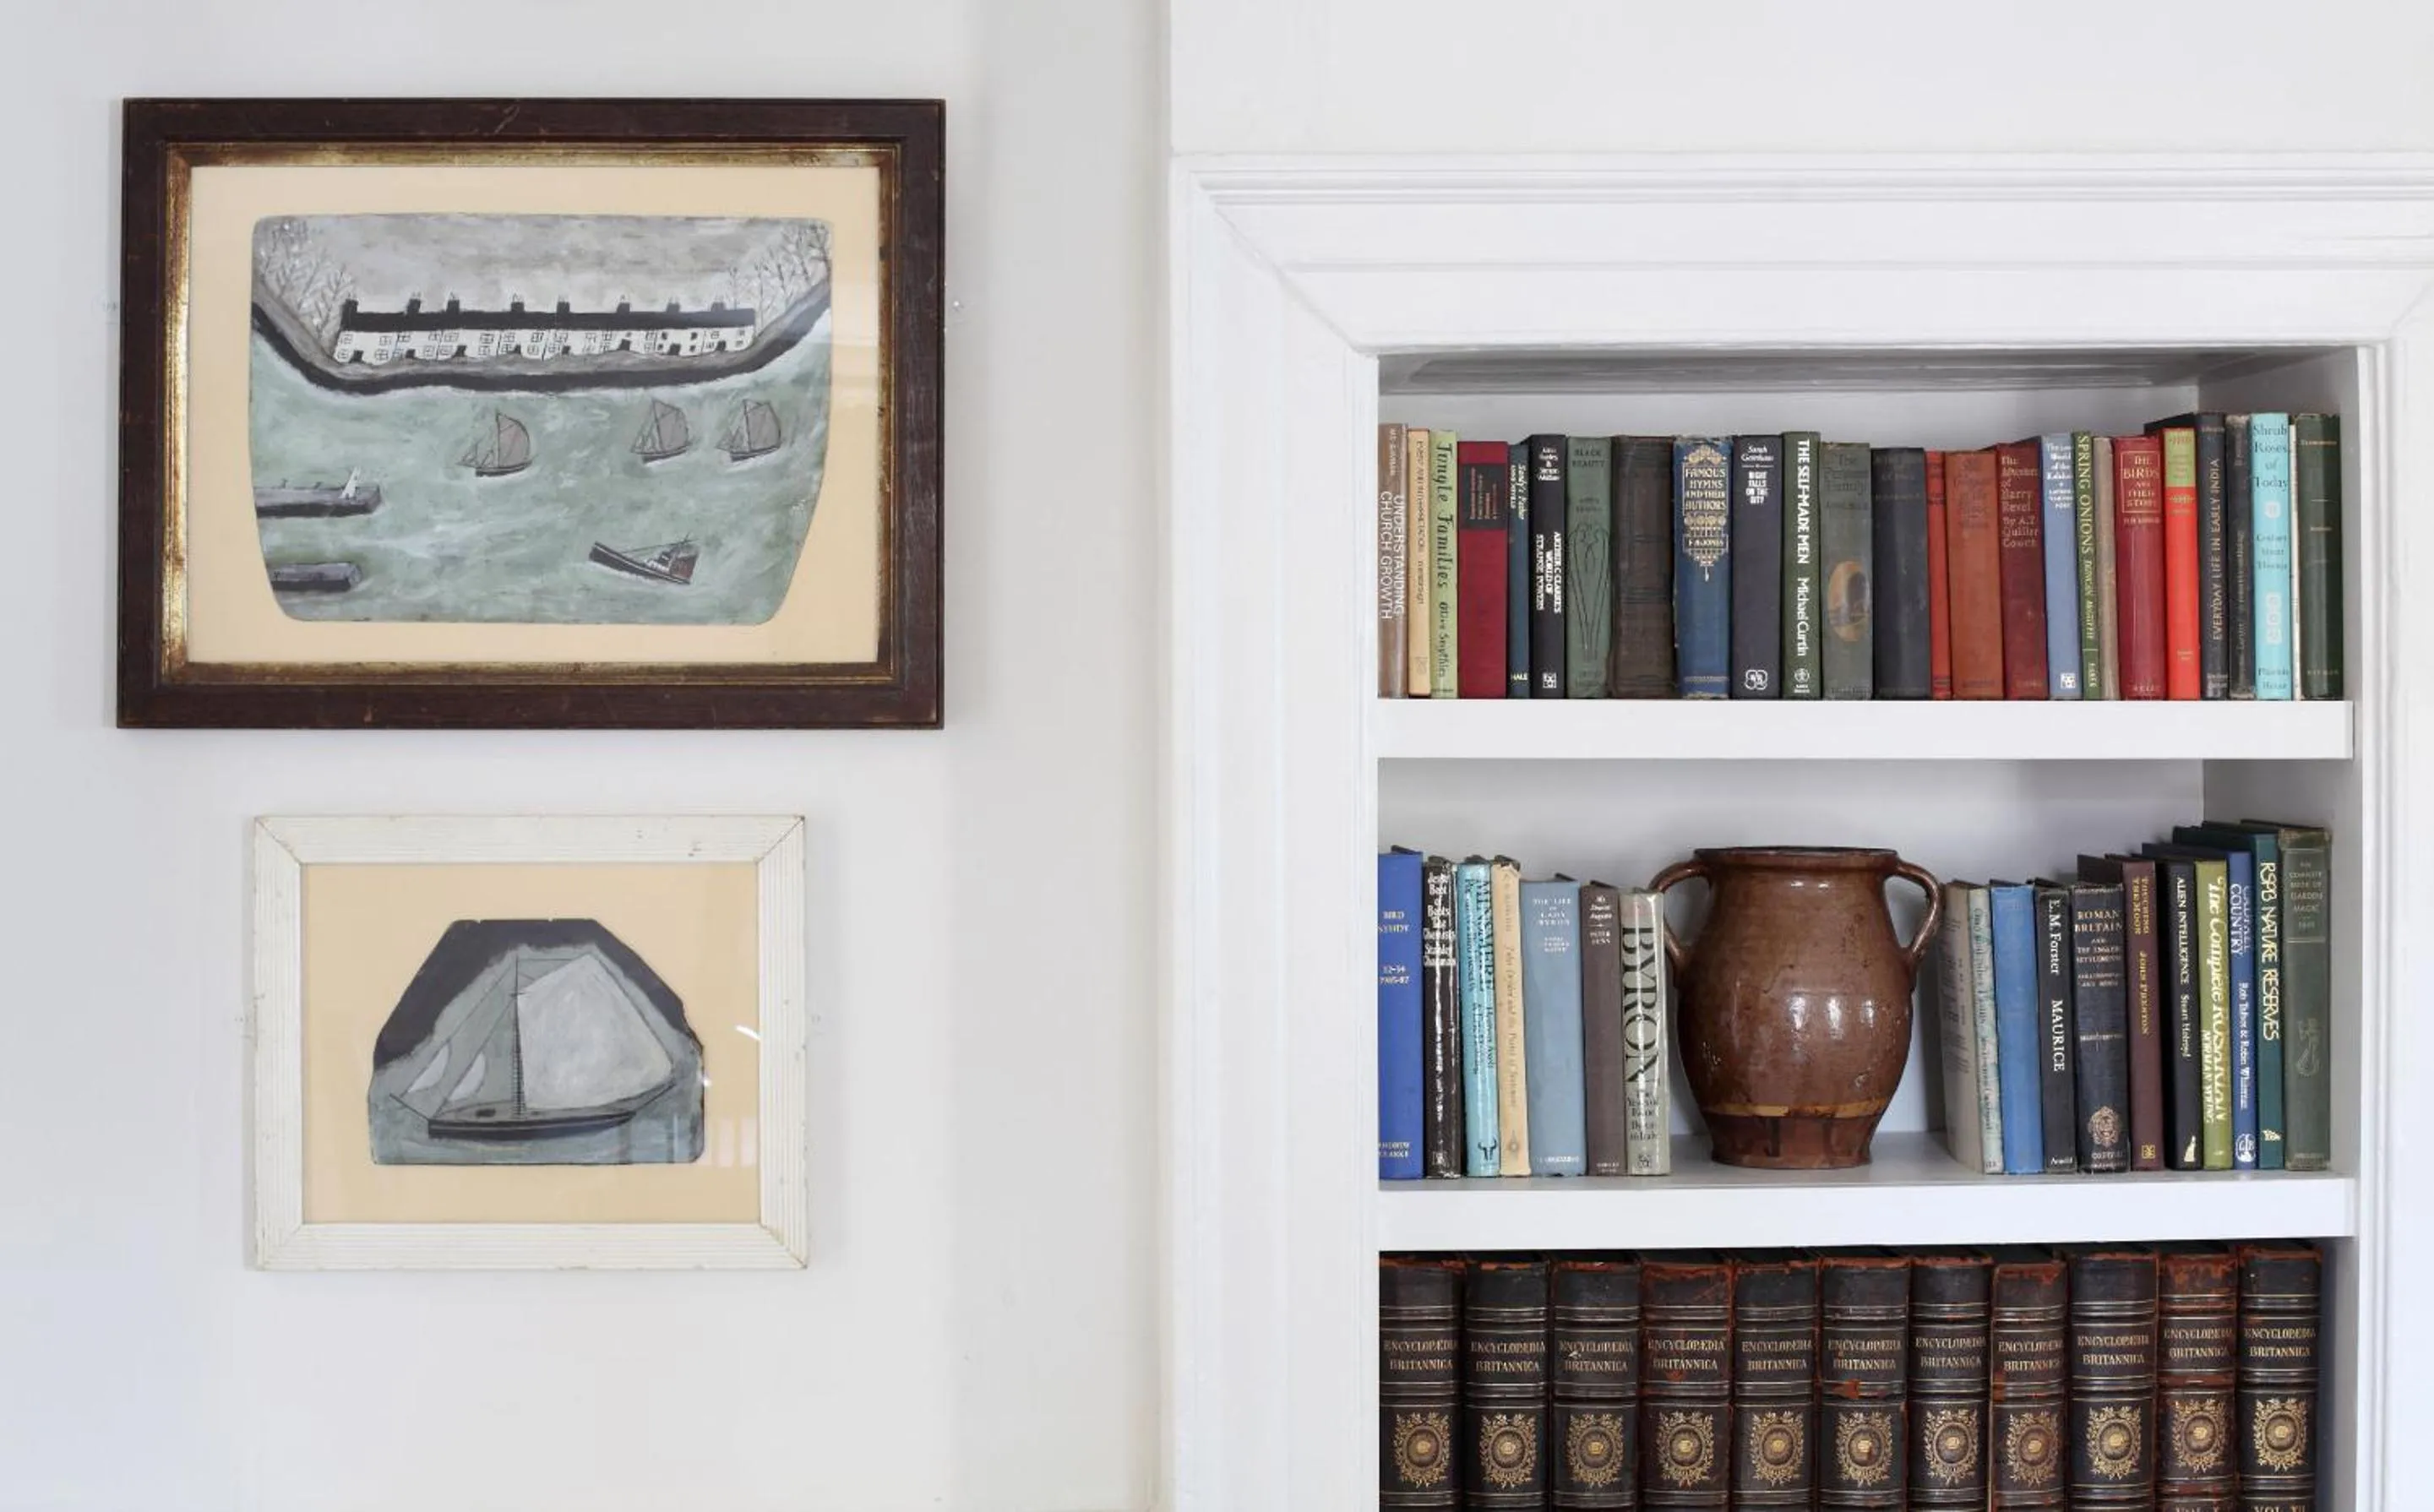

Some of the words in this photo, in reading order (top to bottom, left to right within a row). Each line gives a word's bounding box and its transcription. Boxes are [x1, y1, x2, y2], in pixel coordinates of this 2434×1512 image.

[2252, 423, 2288, 437] Shrub
[1574, 449, 1602, 457] BLACK
[1747, 445, 1767, 454] Sarah
[1797, 438, 1811, 465] THE
[2134, 454, 2154, 465] THE
[2253, 441, 2288, 454] Roses
[1433, 442, 1453, 502] Jungle
[1685, 468, 1726, 478] FAMOUS
[2077, 435, 2091, 489] SPRING
[2122, 467, 2160, 480] BIRDS
[2264, 458, 2279, 470] of
[1690, 480, 1723, 489] HYMNS
[1748, 479, 1767, 487] FALLS
[2209, 458, 2220, 494] INDIA
[2253, 475, 2289, 492] Today
[1685, 490, 1702, 499] AND
[1703, 490, 1725, 498] THEIR
[1745, 487, 1756, 496] ON
[1756, 487, 1768, 496] THE
[1797, 465, 1811, 533] SELF-MADE
[2001, 489, 2032, 502] Harry
[1685, 499, 1726, 511] AUTHORS
[2001, 501, 2031, 512] Revel
[2210, 498, 2221, 533] EARLY
[1380, 491, 1392, 550] CHURCH
[2002, 526, 2039, 537] Quiller
[2079, 493, 2093, 554] ONIONS
[1393, 494, 1405, 615] UNDERSTANDING
[1436, 509, 1454, 589] Families
[1536, 533, 1544, 574] STRANGE
[1554, 531, 1562, 567] ARTHUR
[1797, 535, 1811, 564] MEN
[2002, 538, 2037, 548] Couch
[2211, 537, 2221, 551] IN
[1545, 550, 1554, 583] WORLD
[2211, 555, 2222, 578] LIFE
[1380, 555, 1392, 619] GROWTH
[1536, 574, 1544, 611] POWERS
[1545, 583, 1554, 595] OF
[1554, 574, 1562, 614] CLARKE'S
[1797, 577, 1810, 621] Michael
[1439, 601, 1449, 629] Olive
[2212, 583, 2223, 640] EVERYDAY
[1797, 621, 1809, 656] Curtin
[2132, 877, 2141, 901] THE
[2177, 877, 2187, 907] ALIEN
[2260, 862, 2279, 902] RSPB
[2141, 877, 2150, 934] TOUCHING
[2208, 876, 2226, 915] The
[2290, 891, 2323, 900] GARDEN
[1382, 911, 1405, 919] BIRD
[1538, 919, 1571, 927] BYRON
[1540, 911, 1566, 919] LADY
[2077, 910, 2120, 920] ROMAN
[2132, 901, 2142, 935] MOON
[2230, 883, 2244, 957] COUNTRY
[2074, 922, 2123, 933] BRITAIN
[2261, 906, 2279, 963] NATURE
[2050, 932, 2061, 976] Forster
[2178, 911, 2190, 985] INTELLIGENCE
[2207, 917, 2227, 1002] Complete
[2139, 951, 2148, 981] JOHN
[2239, 982, 2249, 999] Rob
[1621, 926, 1660, 1085] BYRON
[2180, 993, 2190, 1020] Stuart
[2239, 1000, 2250, 1028] Talbot
[2262, 967, 2279, 1040] RESERVES
[2051, 999, 2065, 1072] MAURICE
[2240, 1029, 2250, 1038] &
[2202, 1030, 2213, 1081] NORMAN
[2240, 1040, 2251, 1064] Robin
[1920, 1356, 1982, 1368] BRITANNICA
[2083, 1353, 2145, 1365] BRITANNICA
[2169, 1346, 2231, 1359] BRITANNICA
[2250, 1346, 2311, 1357] BRITANNICA
[1390, 1358, 1454, 1371] BRITANNICA
[1475, 1360, 1540, 1372] BRITANNICA
[1564, 1360, 1628, 1372] BRITANNICA
[1653, 1358, 1718, 1370] BRITANNICA
[1747, 1358, 1808, 1371] BRITANNICA
[1833, 1358, 1897, 1370] BRITANNICA
